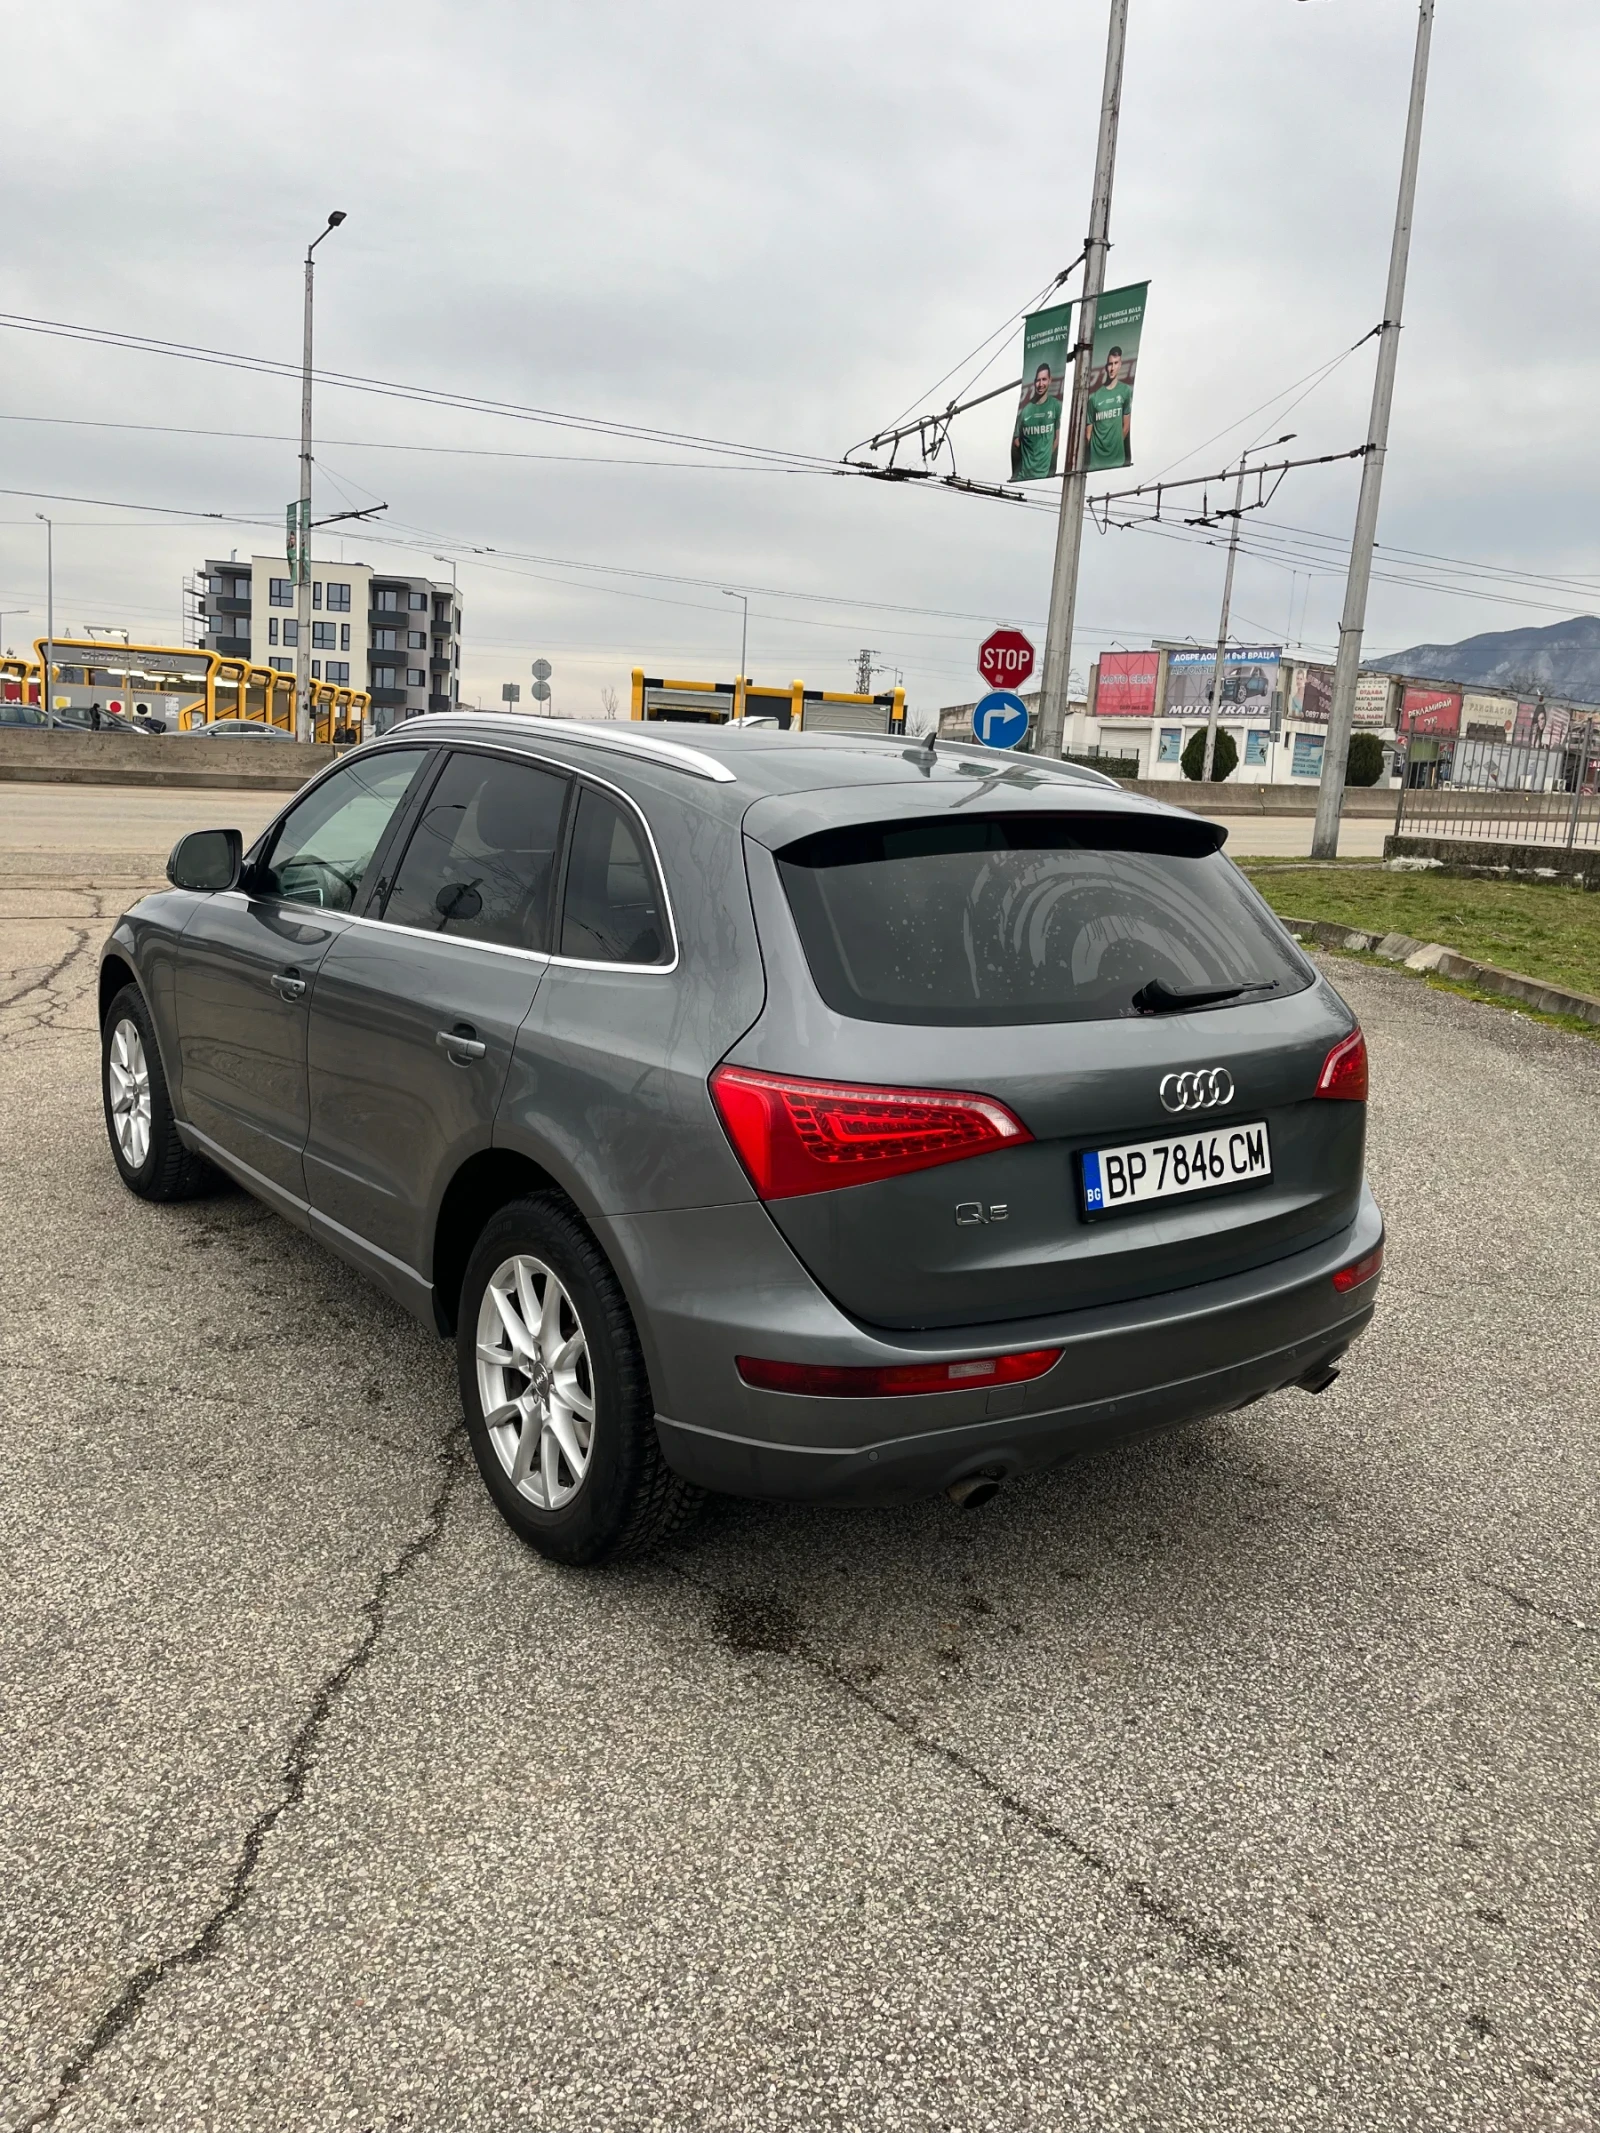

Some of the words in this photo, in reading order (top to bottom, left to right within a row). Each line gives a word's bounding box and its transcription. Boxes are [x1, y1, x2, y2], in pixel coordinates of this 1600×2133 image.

[1095, 407, 1122, 421] WINBET
[1022, 423, 1055, 436] WINBET
[983, 647, 1030, 671] STOP
[1174, 653, 1200, 662] ДОБРЕ
[1247, 651, 1275, 661] ВРАЦА
[1407, 697, 1452, 718] РЕКЛАМИРАЙ
[1152, 1137, 1225, 1191] 7846
[1086, 1187, 1101, 1203] BG
[955, 1201, 1009, 1226] Q5
